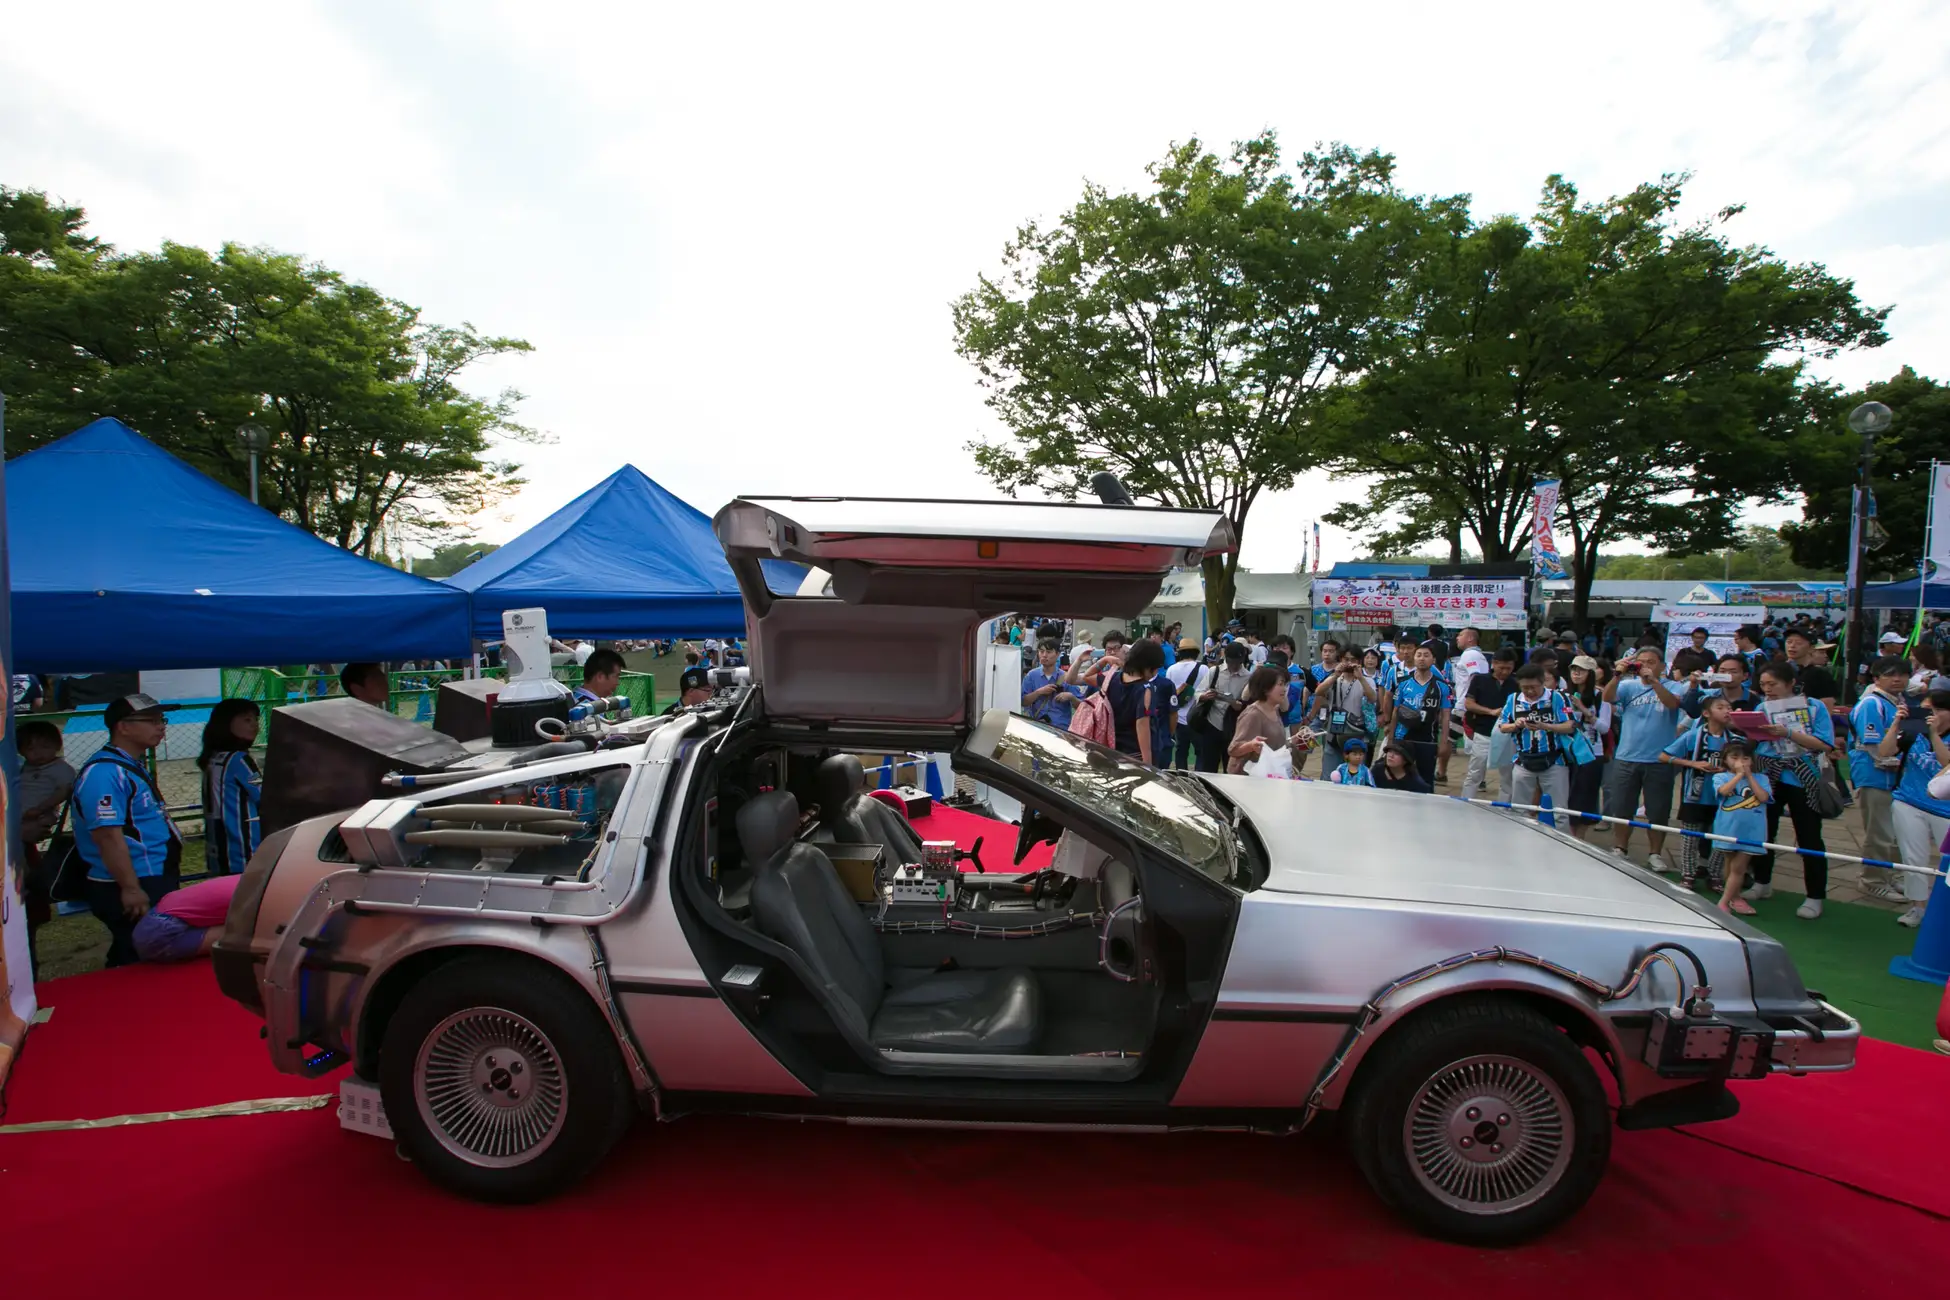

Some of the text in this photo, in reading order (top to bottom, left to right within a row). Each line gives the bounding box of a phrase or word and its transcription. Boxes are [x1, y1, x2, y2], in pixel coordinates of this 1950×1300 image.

[1337, 596, 1490, 609] 今すぐここで入会できます
